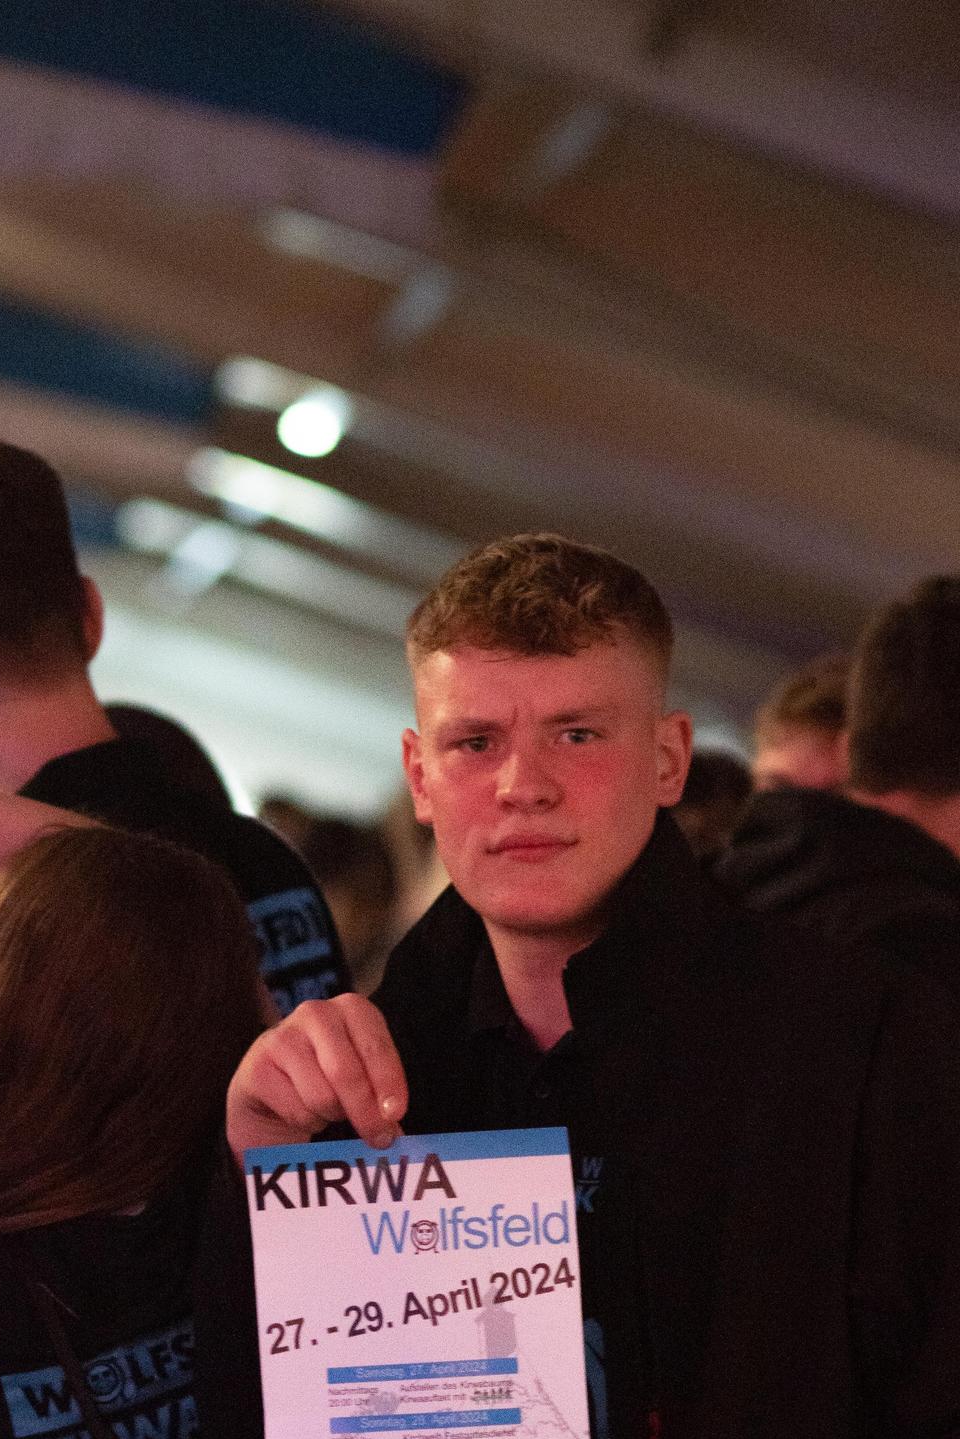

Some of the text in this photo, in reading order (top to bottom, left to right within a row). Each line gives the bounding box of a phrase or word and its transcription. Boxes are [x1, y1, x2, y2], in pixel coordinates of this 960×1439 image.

[252, 1152, 457, 1211] KIRWA
[361, 1200, 570, 1255] Wolfsfeld
[266, 1317, 318, 1355] 27.
[344, 1302, 394, 1337] 29.
[402, 1277, 483, 1327] April
[491, 1257, 576, 1304] 2024
